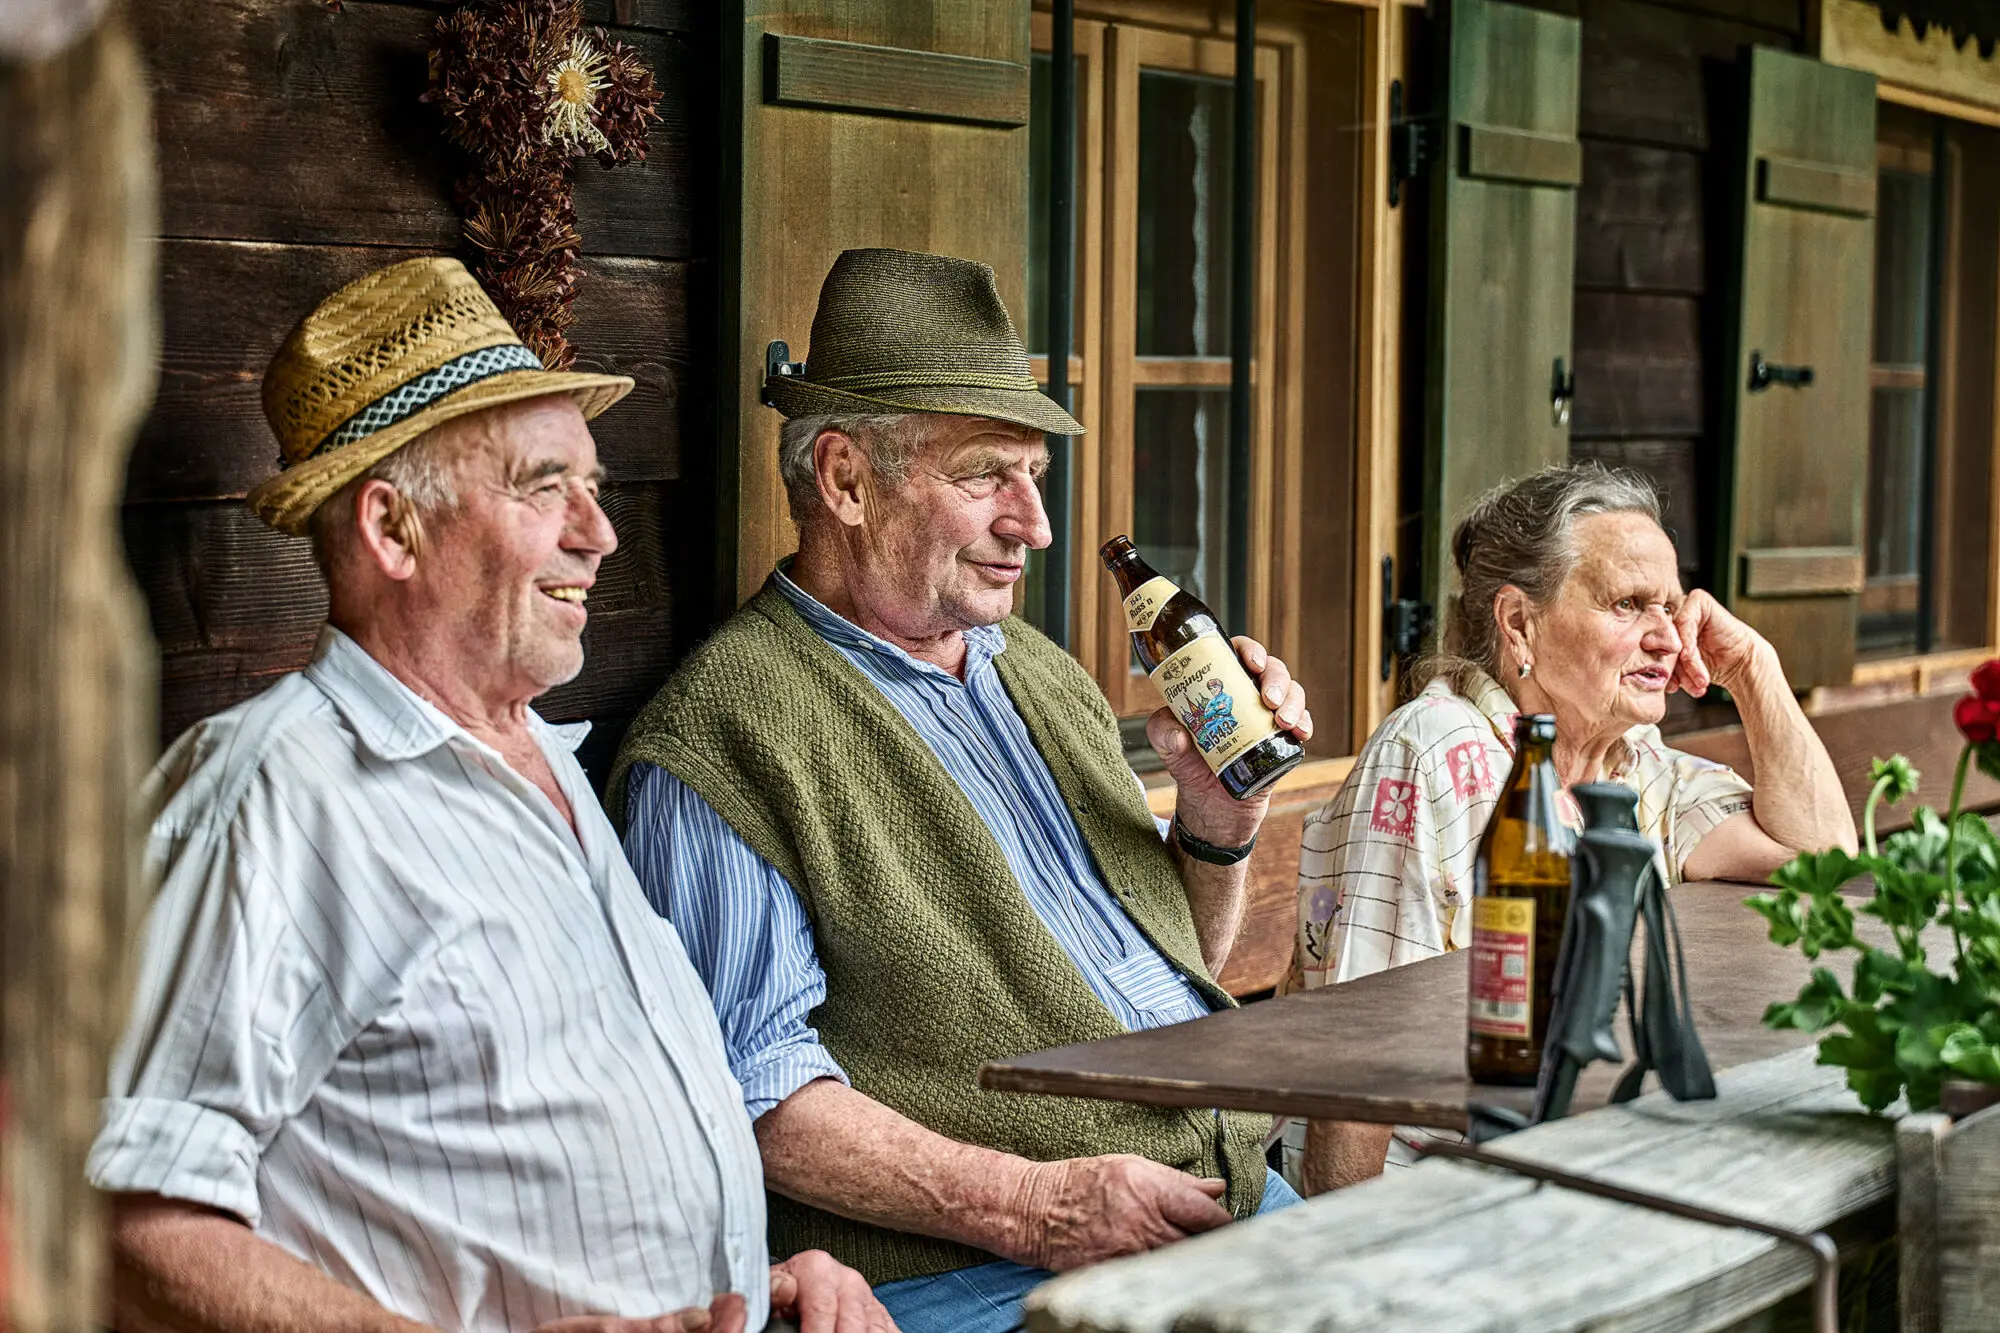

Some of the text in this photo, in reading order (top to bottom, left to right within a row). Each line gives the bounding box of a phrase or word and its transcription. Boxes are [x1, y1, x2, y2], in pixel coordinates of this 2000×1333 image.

[1130, 593, 1143, 607] 1543
[1164, 662, 1212, 704] Flötzinger
[1205, 720, 1234, 748] 1543
